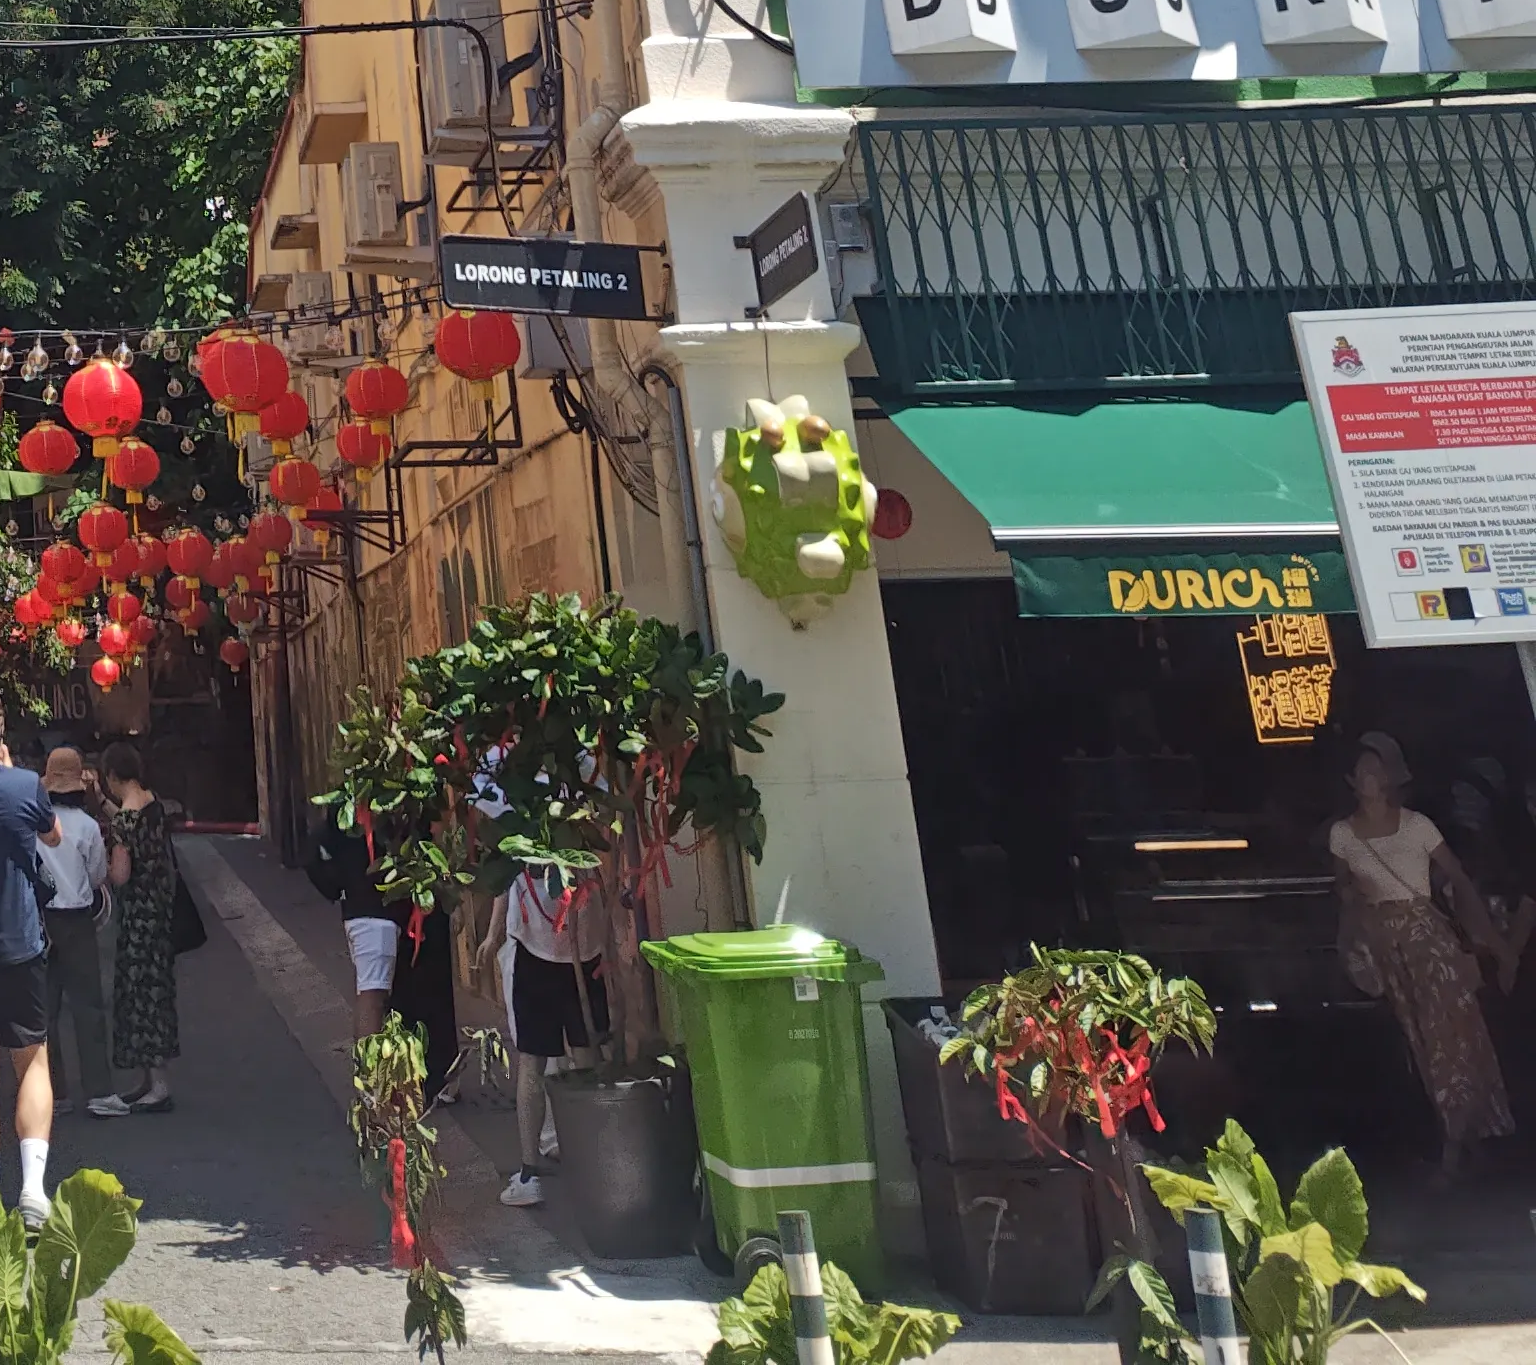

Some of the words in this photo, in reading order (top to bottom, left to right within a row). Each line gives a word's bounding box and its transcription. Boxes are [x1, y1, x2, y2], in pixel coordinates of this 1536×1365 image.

[759, 248, 780, 277] LORONG
[778, 228, 804, 262] PETALING
[801, 225, 809, 243] 2
[455, 262, 527, 285] LORONG
[530, 268, 614, 290] PETALING
[617, 274, 629, 291] 2
[1399, 334, 1429, 343] DEWAN
[1429, 332, 1476, 341] BANDARAYA
[1476, 331, 1502, 339] KUALA
[1502, 329, 1536, 338] LUMPUR
[1407, 343, 1444, 352] PERINTAH
[1446, 341, 1508, 350] PENGANGKUTAN
[1510, 339, 1533, 348] JALAN
[1402, 354, 1457, 363] (PERUNTUKAN
[1458, 352, 1488, 360] TEMPAT
[1489, 351, 1512, 359] LETAK
[1391, 365, 1425, 373] WILAYAH
[1426, 362, 1480, 372] PERSEKUTUAN
[1482, 361, 1507, 369] KUALA
[1384, 385, 1418, 395] TEMPAT
[1419, 384, 1446, 394] LETAK
[1447, 382, 1479, 392] KERETA
[1480, 381, 1524, 391] BERBAYAR
[1411, 394, 1456, 404] KAWASAN
[1457, 392, 1484, 402] PUSAT
[1485, 391, 1523, 400] BANDAR
[1458, 408, 1476, 416] BAGI
[1483, 407, 1498, 415] JAM
[1498, 406, 1533, 414] PERTAMA
[1345, 432, 1367, 440] MASA
[1368, 430, 1404, 440] KAWALAN
[1347, 458, 1395, 466] PERINGATAN:
[1359, 469, 1375, 477] SILA
[1375, 468, 1398, 476] BAYAR
[1399, 467, 1412, 475] CAJ
[1412, 466, 1432, 474] YANG
[1433, 464, 1476, 473] DITETAPKAN
[1362, 479, 1405, 488] KENDERAAN
[1406, 478, 1442, 486] DILARANG
[1444, 476, 1485, 485] DILETAKKAN
[1364, 490, 1404, 498] HALANGAN
[1415, 498, 1441, 506] ORANG
[1442, 497, 1462, 505] YANG
[1463, 496, 1488, 504] GAGAL
[1488, 494, 1528, 502] MEMATUHI
[1369, 510, 1402, 519] DIDENDA
[1402, 509, 1424, 517] TIDAK
[1372, 524, 1403, 532] KAEDAH
[1404, 523, 1437, 531] BAYARAN
[1438, 521, 1452, 529] CAJ
[1487, 519, 1501, 527] PAS
[1402, 533, 1435, 541] APLIKASI
[1445, 531, 1477, 539] TELEFON
[1478, 530, 1504, 538] PINTAR
